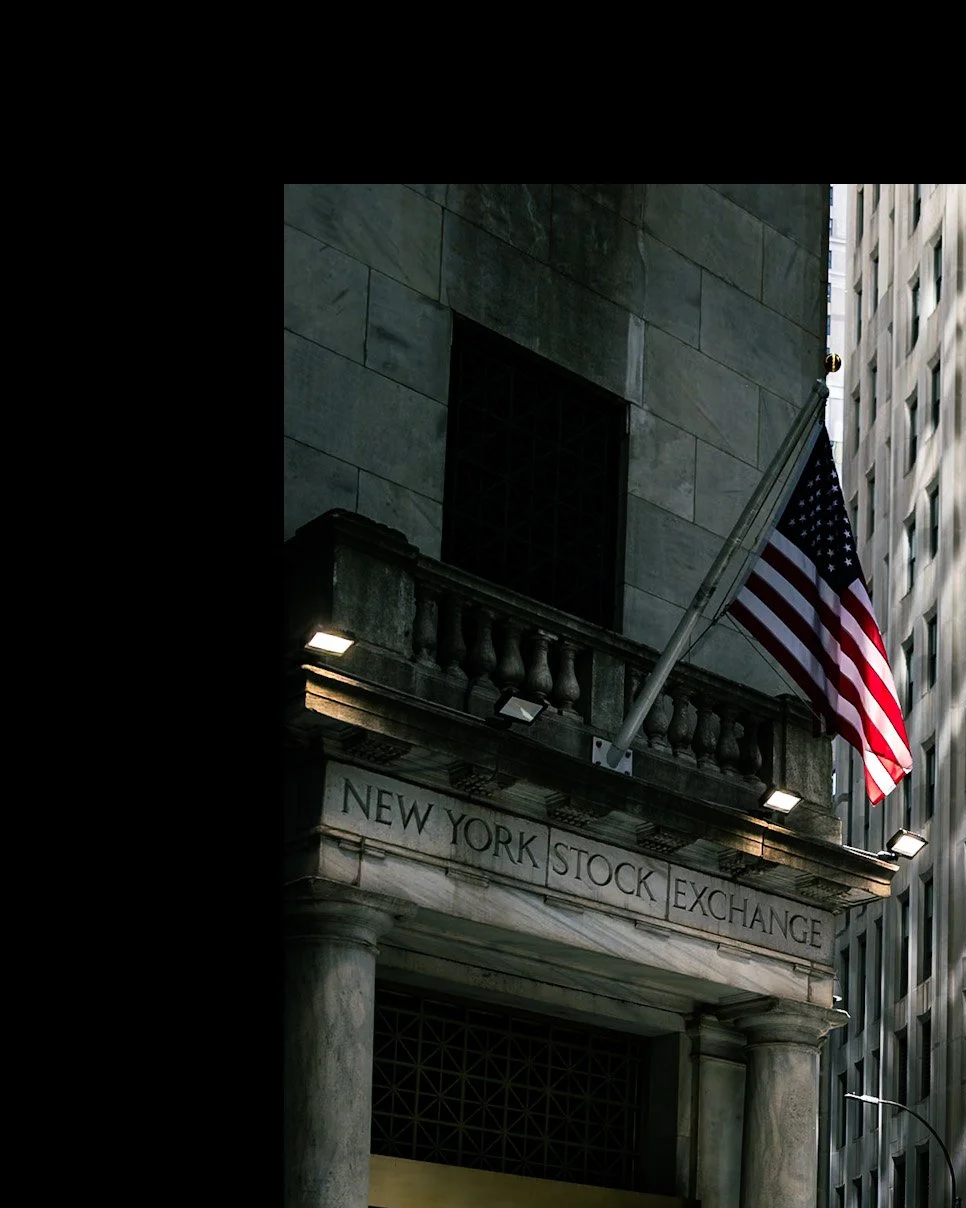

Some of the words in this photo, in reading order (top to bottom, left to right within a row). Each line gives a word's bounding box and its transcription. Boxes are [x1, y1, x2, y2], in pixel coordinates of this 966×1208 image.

[342, 777, 434, 835] NEW
[444, 808, 540, 869] YORK
[553, 841, 656, 902] STOCK
[673, 877, 822, 949] EXCHANGE
